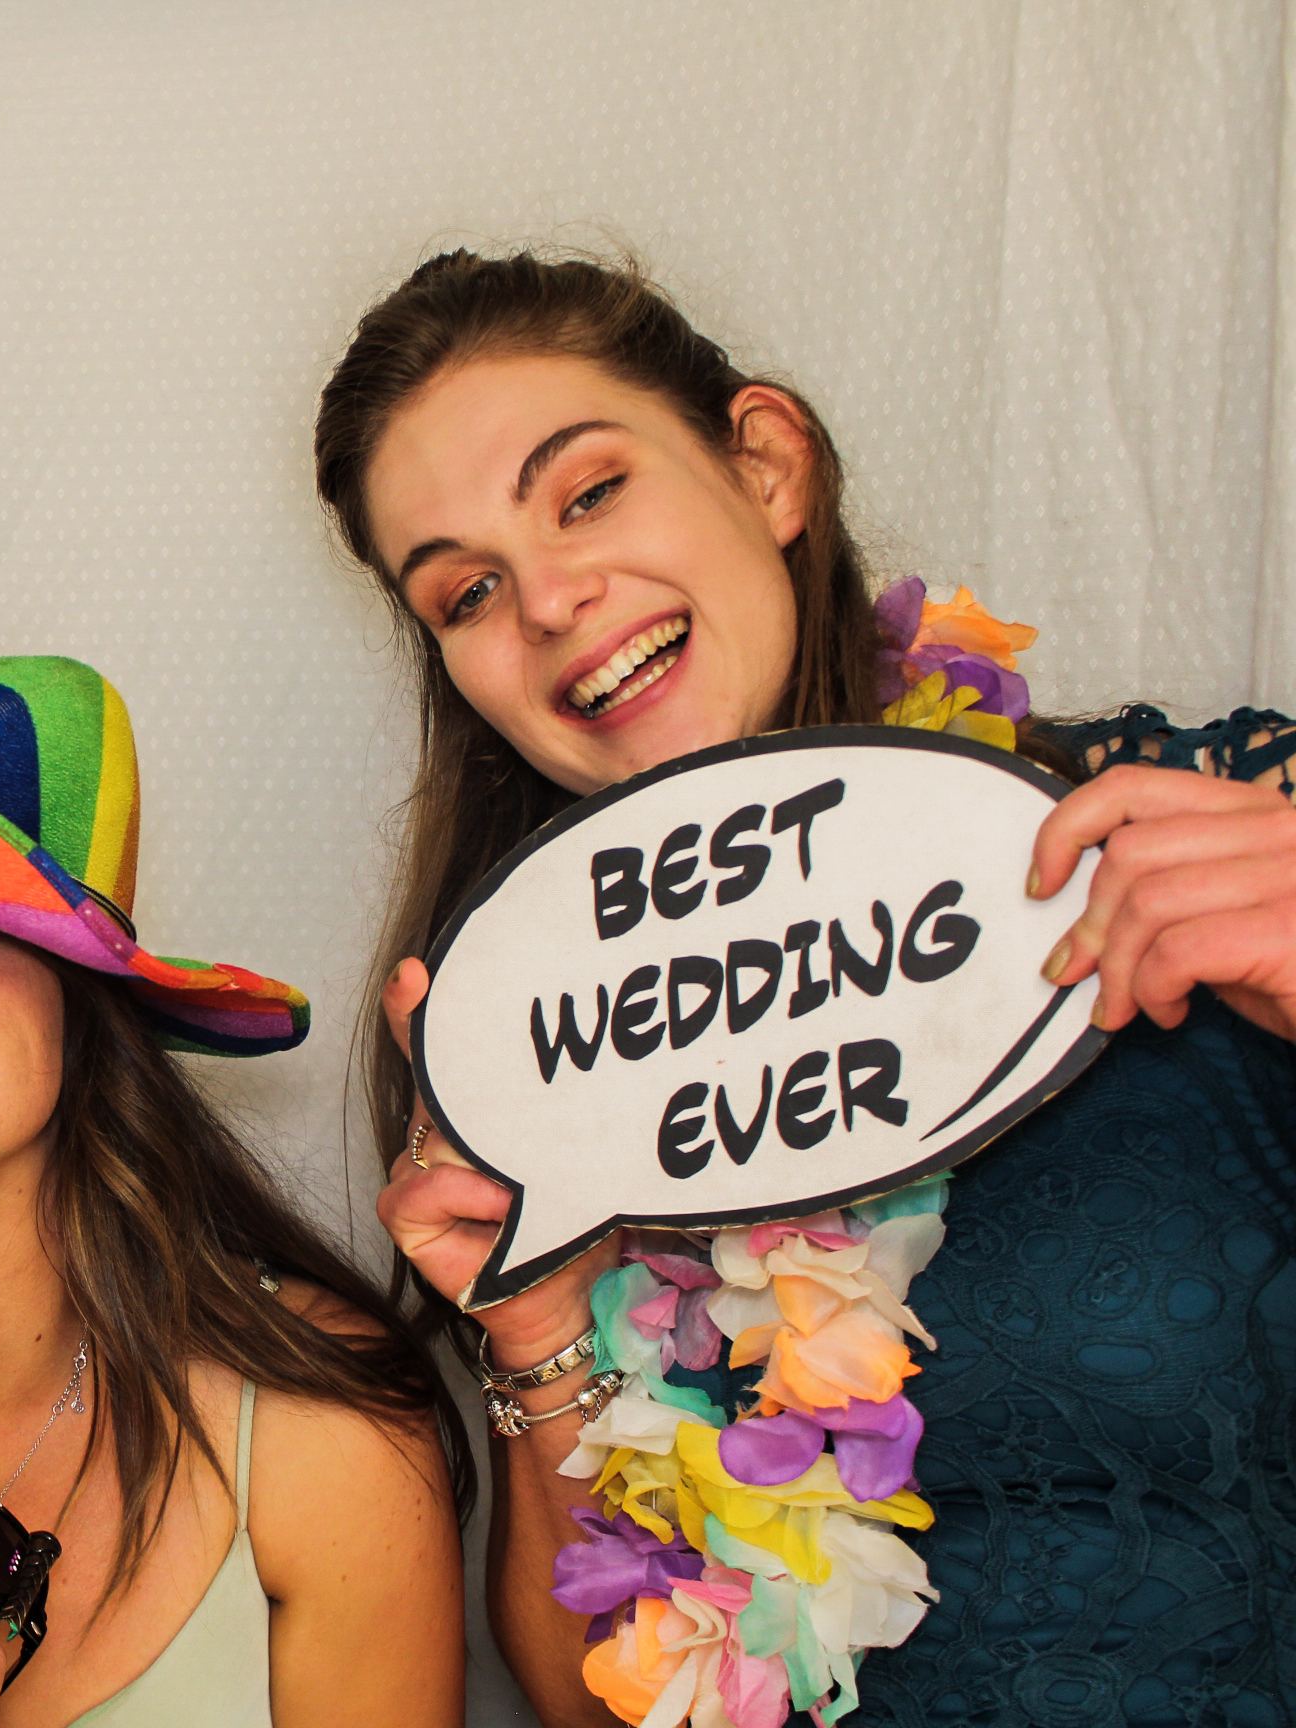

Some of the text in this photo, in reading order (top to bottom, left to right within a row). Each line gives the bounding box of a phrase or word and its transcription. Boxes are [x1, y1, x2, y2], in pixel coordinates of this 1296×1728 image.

[591, 778, 845, 941] BEST
[530, 880, 981, 1084] WEDDING
[657, 1038, 908, 1179] EVER
